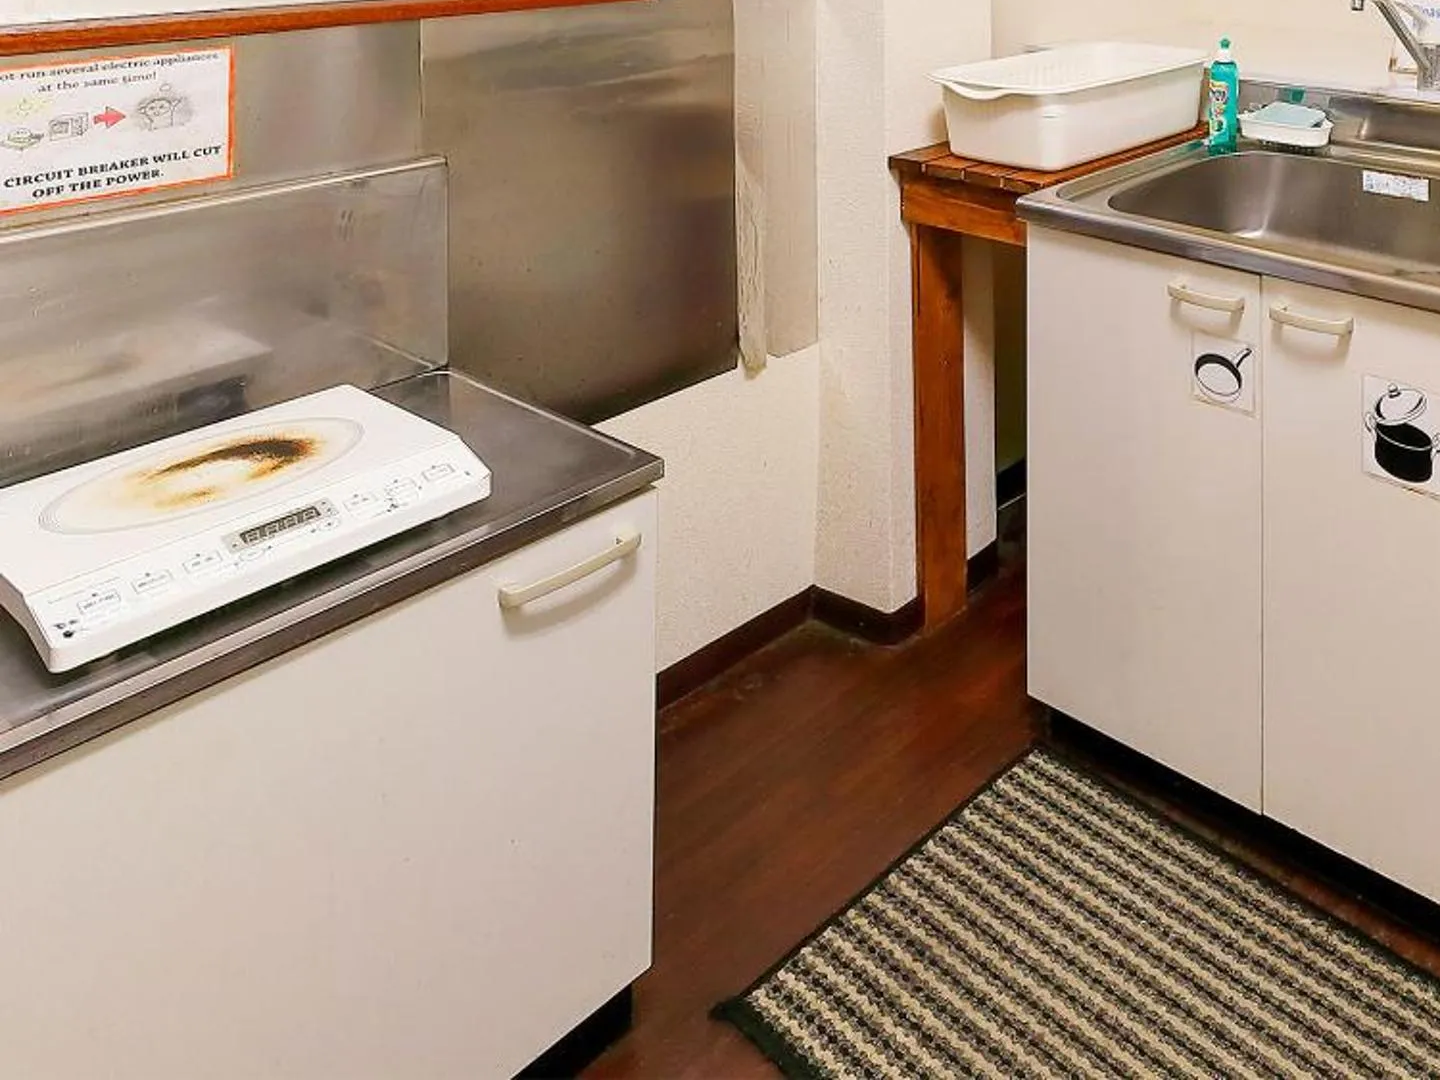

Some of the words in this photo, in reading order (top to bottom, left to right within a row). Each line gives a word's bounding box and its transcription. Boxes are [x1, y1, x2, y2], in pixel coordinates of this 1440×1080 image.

[20, 71, 46, 80] run
[49, 63, 99, 76] several
[101, 57, 151, 72] electric
[153, 51, 220, 68] appliances
[38, 83, 52, 93] at
[57, 80, 79, 90] the
[84, 77, 118, 88] same
[122, 71, 157, 83] time!
[4, 169, 74, 188] CIRCUIT
[78, 157, 150, 177] BREAKER
[153, 151, 190, 165] WILL
[193, 145, 222, 159] CUT
[32, 184, 65, 199] OFF
[69, 179, 101, 193] THE
[105, 169, 165, 187] POWER.
